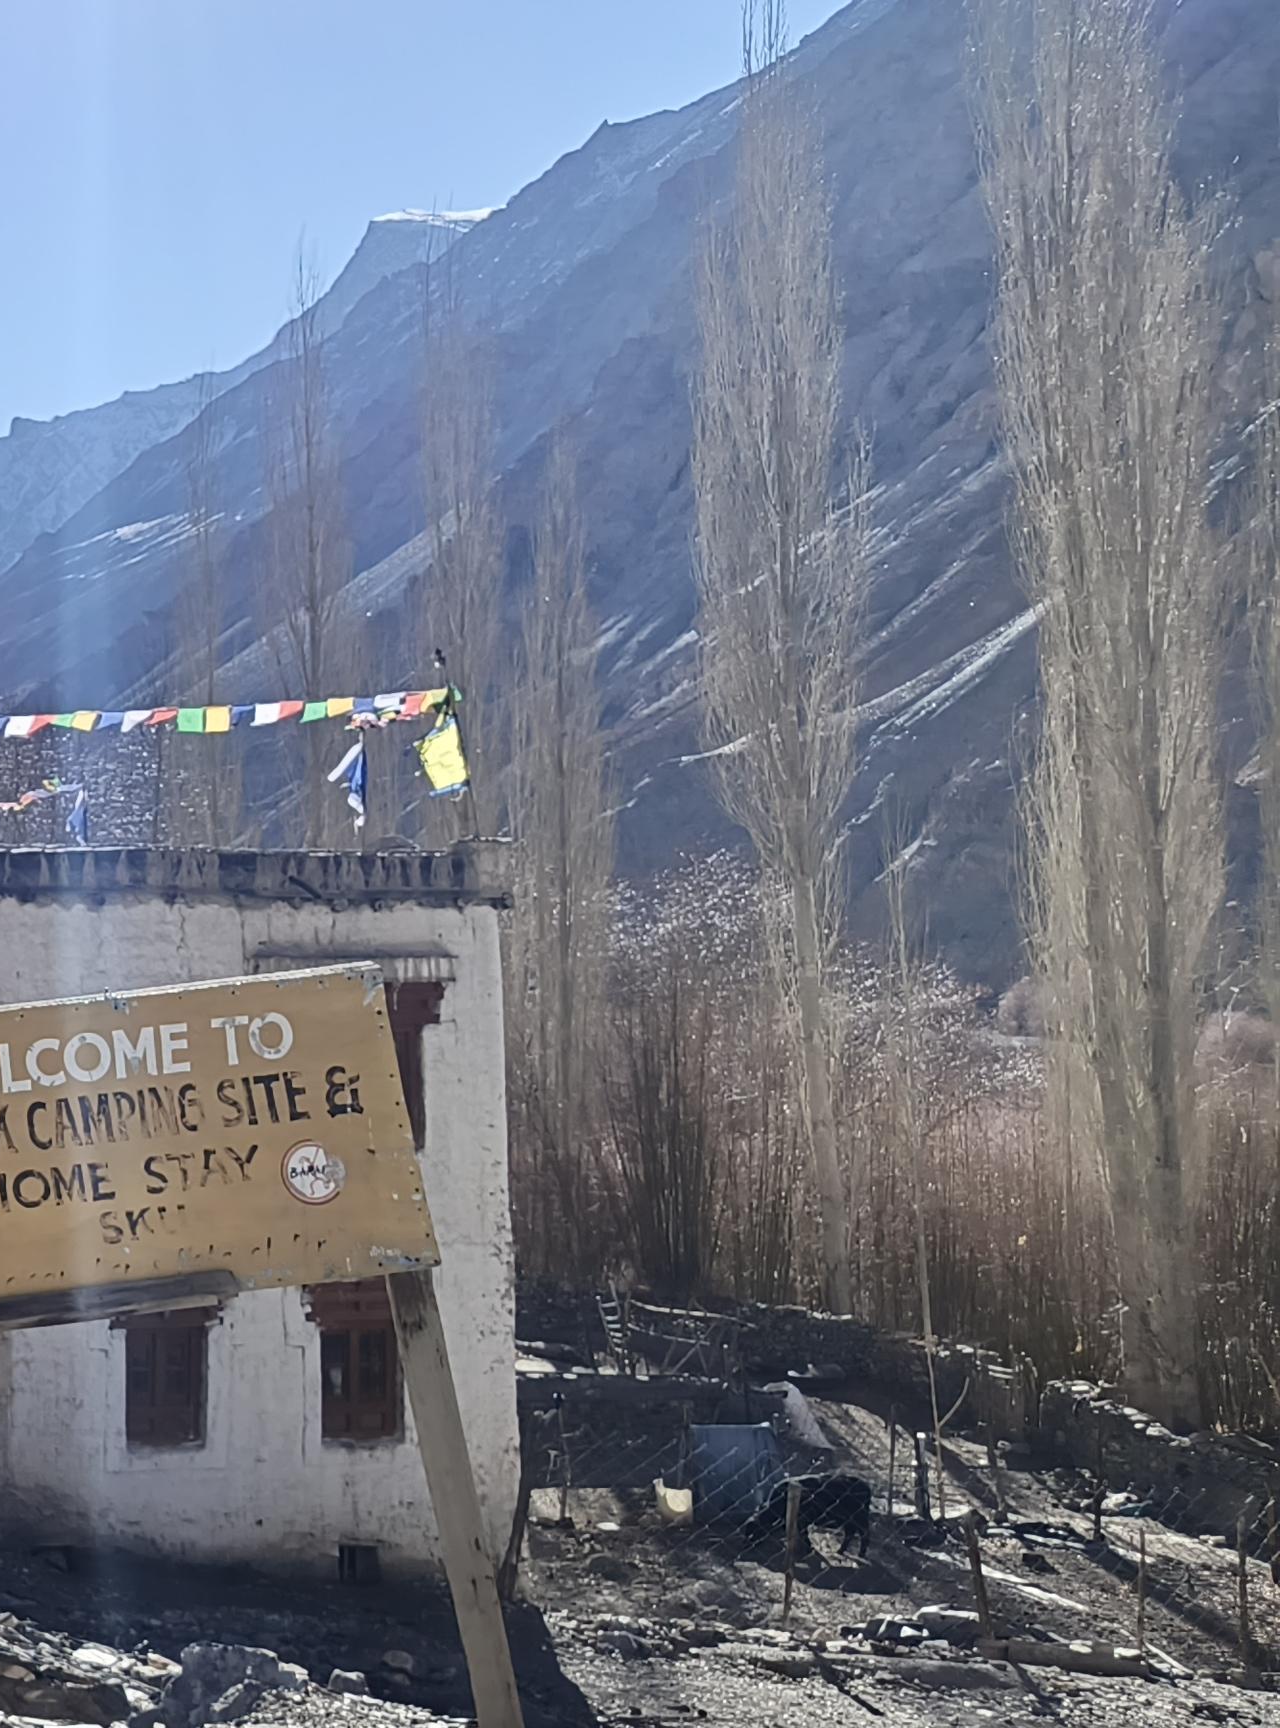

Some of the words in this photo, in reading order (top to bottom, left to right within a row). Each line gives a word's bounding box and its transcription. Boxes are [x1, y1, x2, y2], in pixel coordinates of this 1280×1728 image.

[210, 1012, 293, 1066] TO
[26, 1083, 205, 1151] CAMPING
[216, 1071, 312, 1128] SITE
[325, 1065, 364, 1118] &
[143, 1144, 259, 1194] STAY
